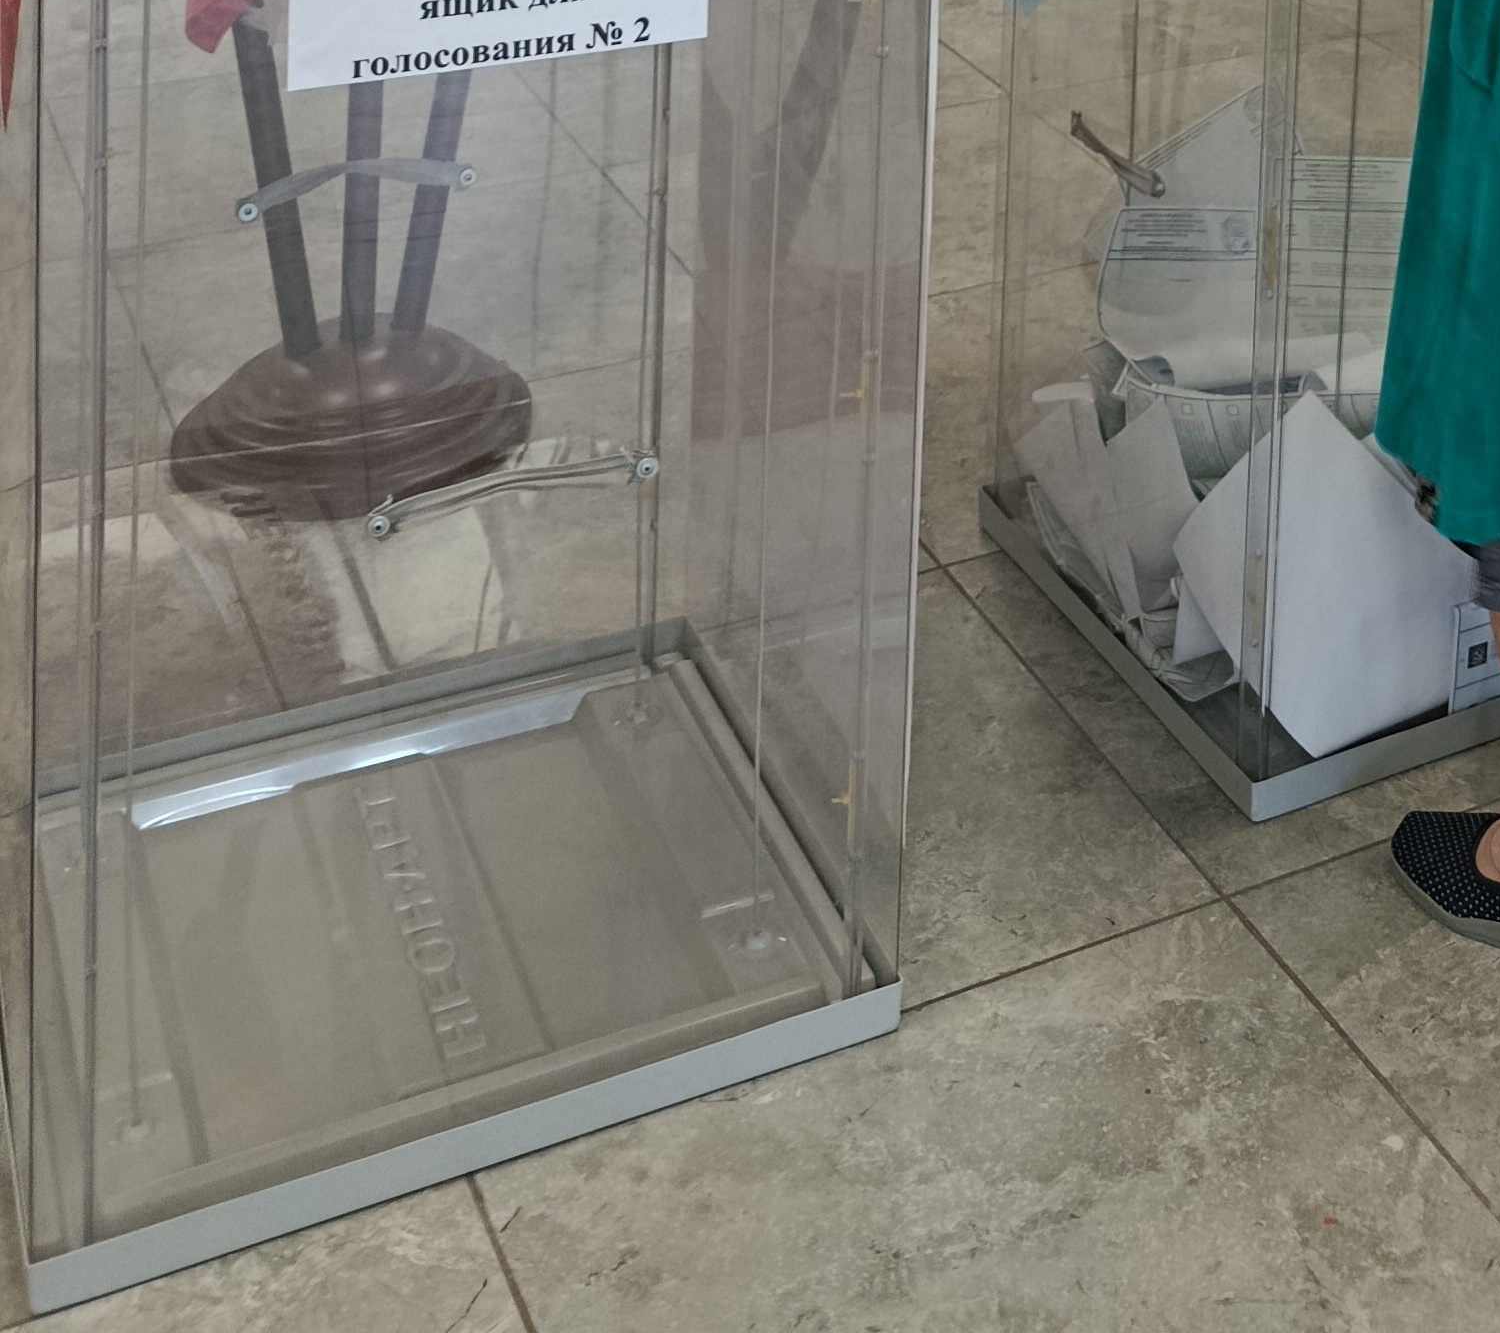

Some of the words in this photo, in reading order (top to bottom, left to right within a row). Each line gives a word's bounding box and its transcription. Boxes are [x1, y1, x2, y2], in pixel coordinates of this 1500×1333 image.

[351, 31, 577, 80] голосования
[585, 21, 624, 50] №
[633, 17, 652, 43] 2
